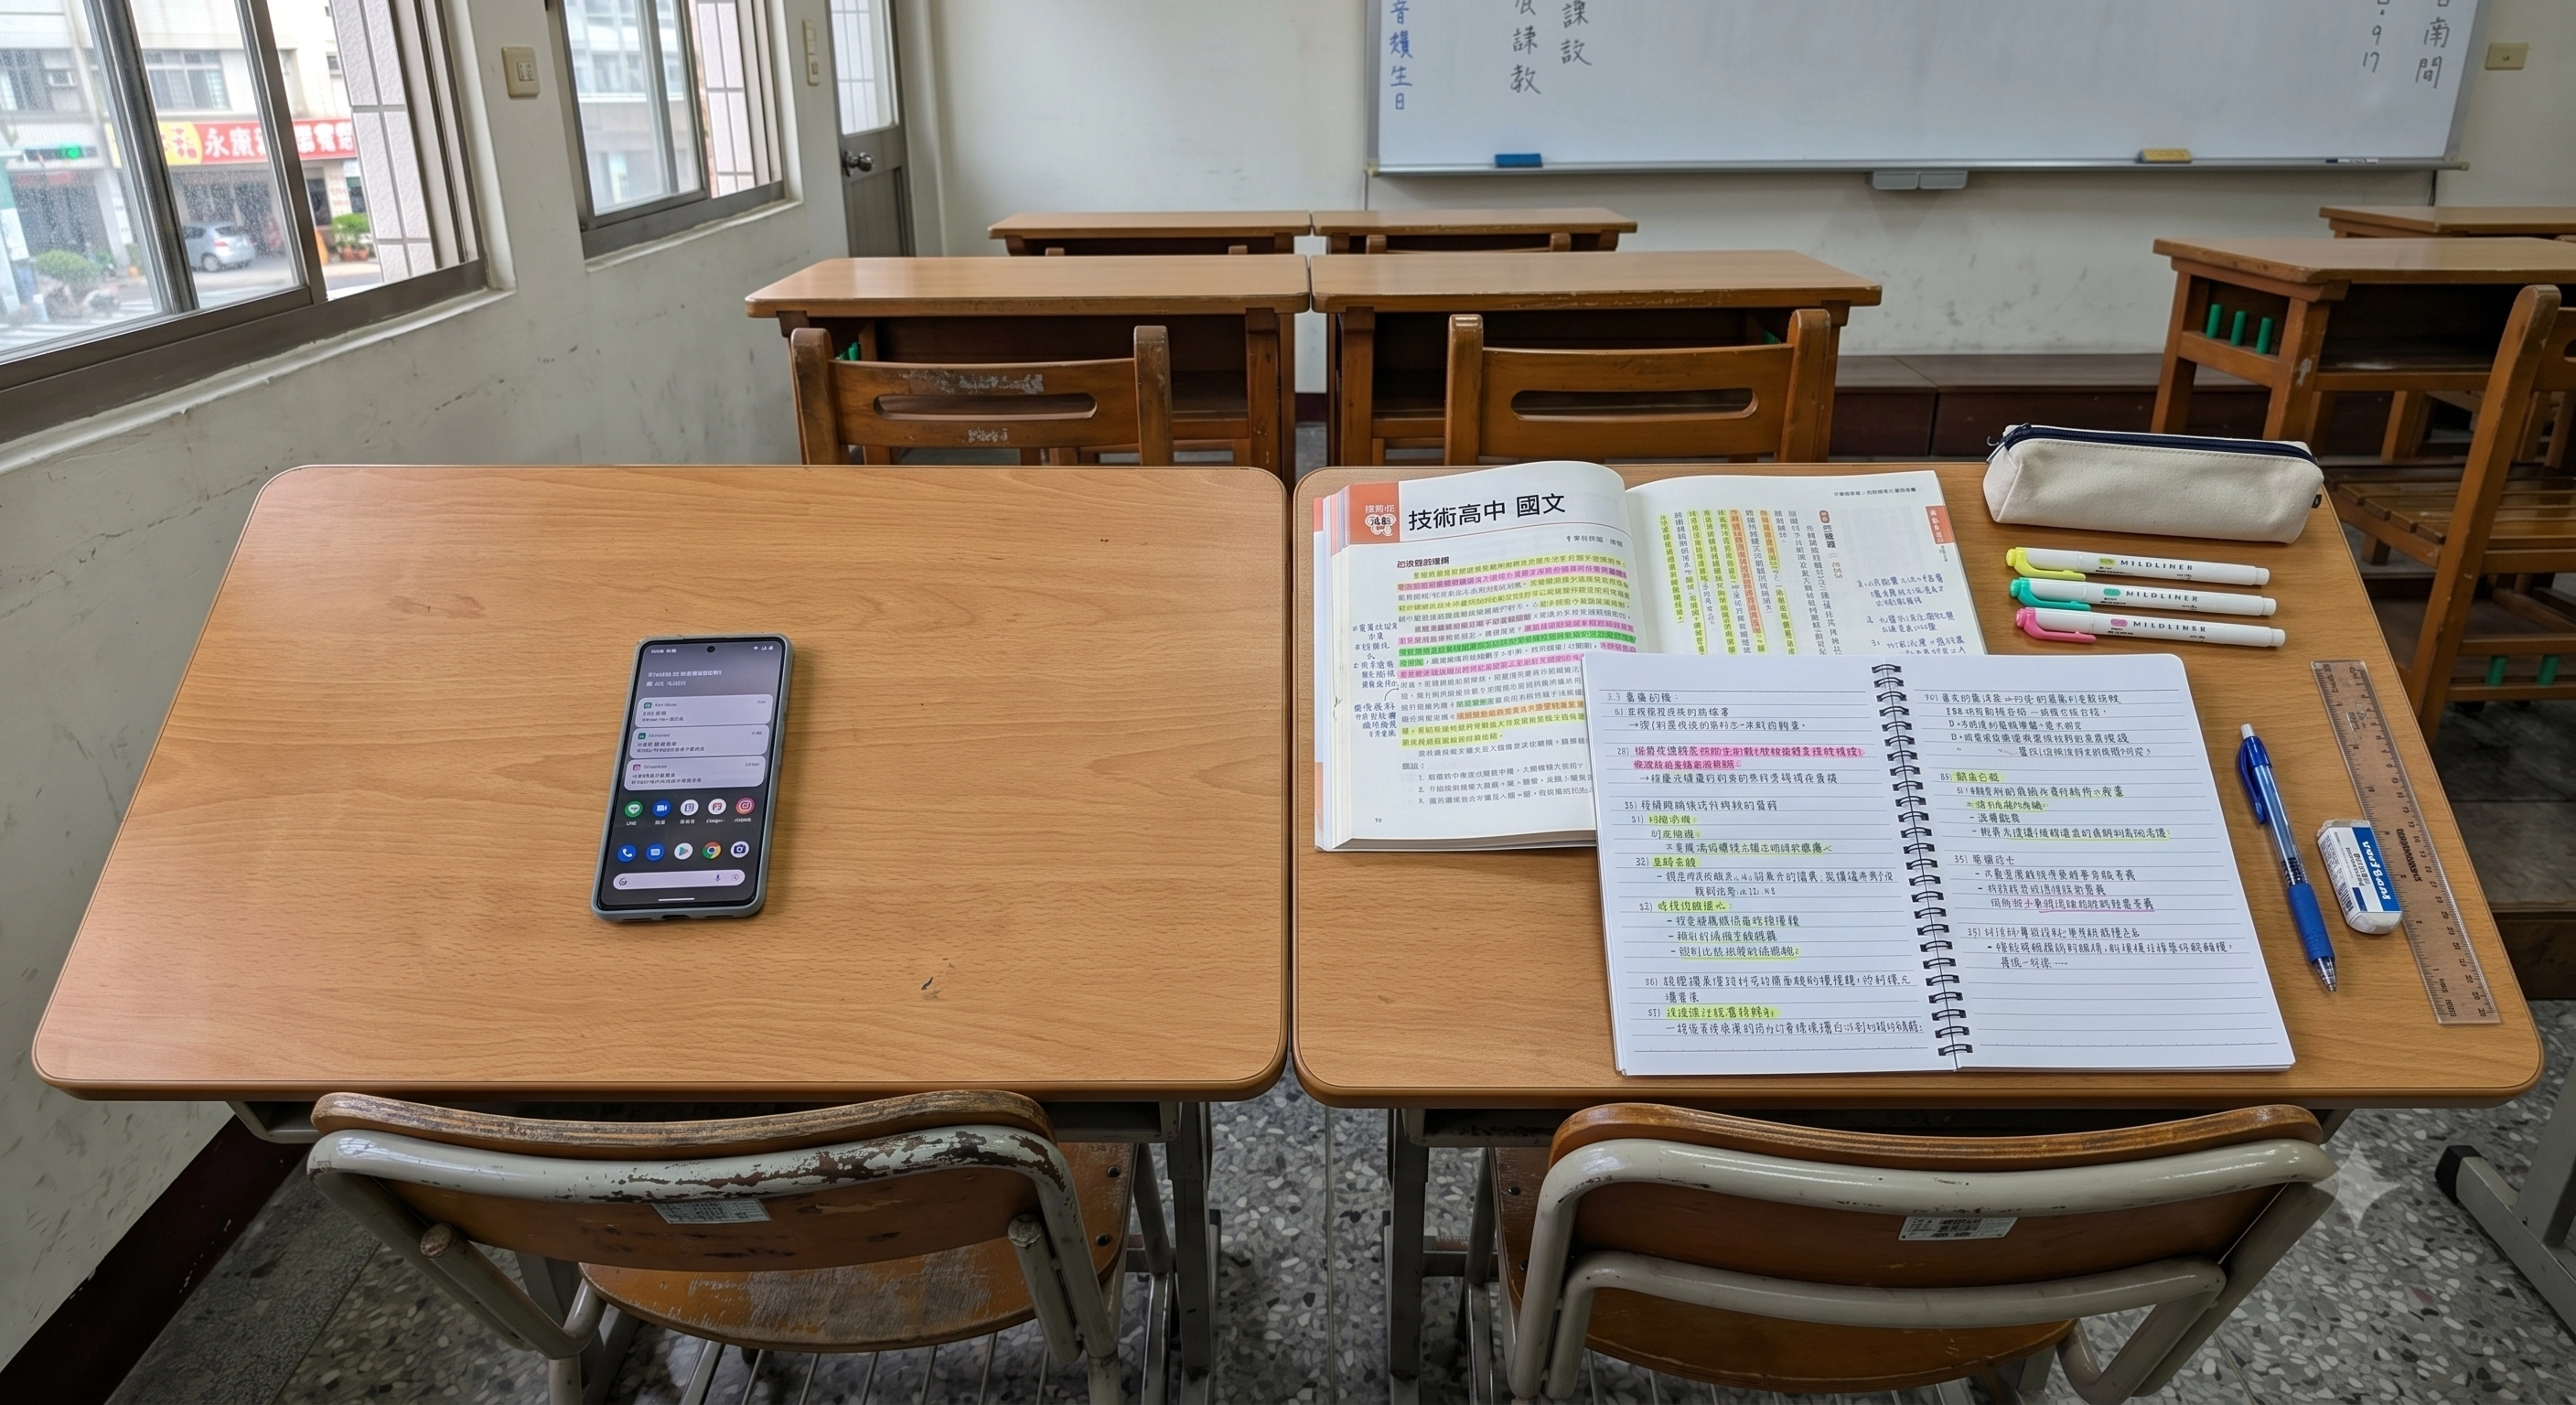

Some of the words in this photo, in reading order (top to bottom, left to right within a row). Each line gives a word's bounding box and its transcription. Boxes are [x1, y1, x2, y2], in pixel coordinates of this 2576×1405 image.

[1408, 499, 1506, 531] 技術高中
[1516, 492, 1567, 519] 國文
[2125, 590, 2199, 603] MILDLINER
